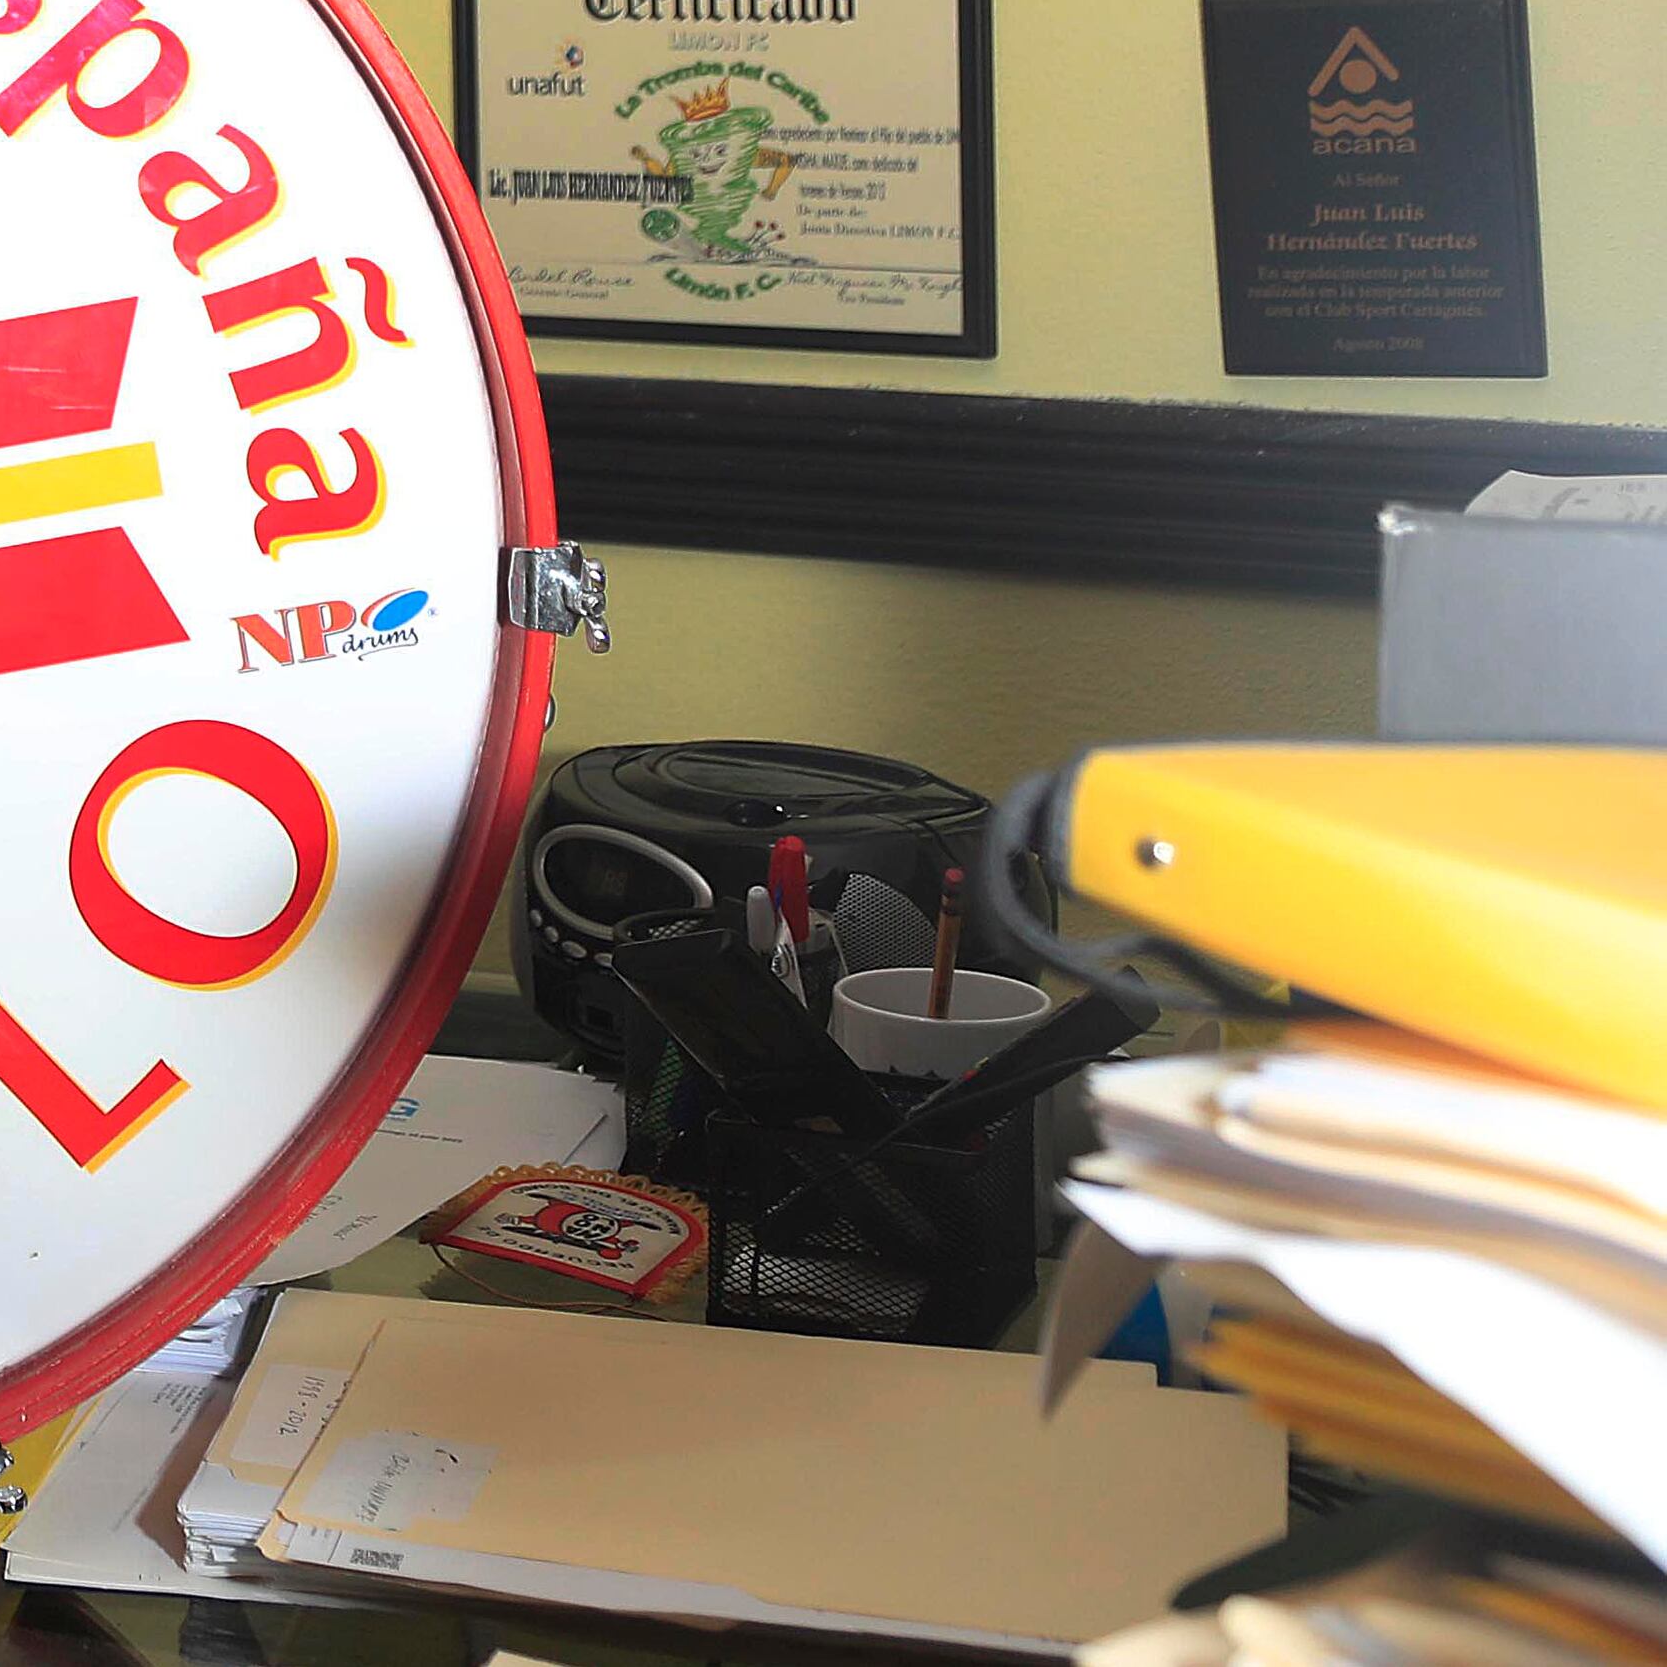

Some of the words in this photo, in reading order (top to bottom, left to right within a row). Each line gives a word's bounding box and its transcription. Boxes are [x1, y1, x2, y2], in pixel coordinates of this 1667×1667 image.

[508, 71, 587, 96] unafut
[1311, 135, 1416, 156] acana
[513, 170, 542, 205] JUAN
[543, 170, 567, 200] LUIS
[568, 172, 642, 203] HERNANDEZ
[1309, 203, 1367, 227] Juan
[1374, 203, 1426, 223] Luis
[1267, 232, 1389, 252] Hernández
[228, 599, 357, 674] NP
[342, 627, 420, 662] drums
